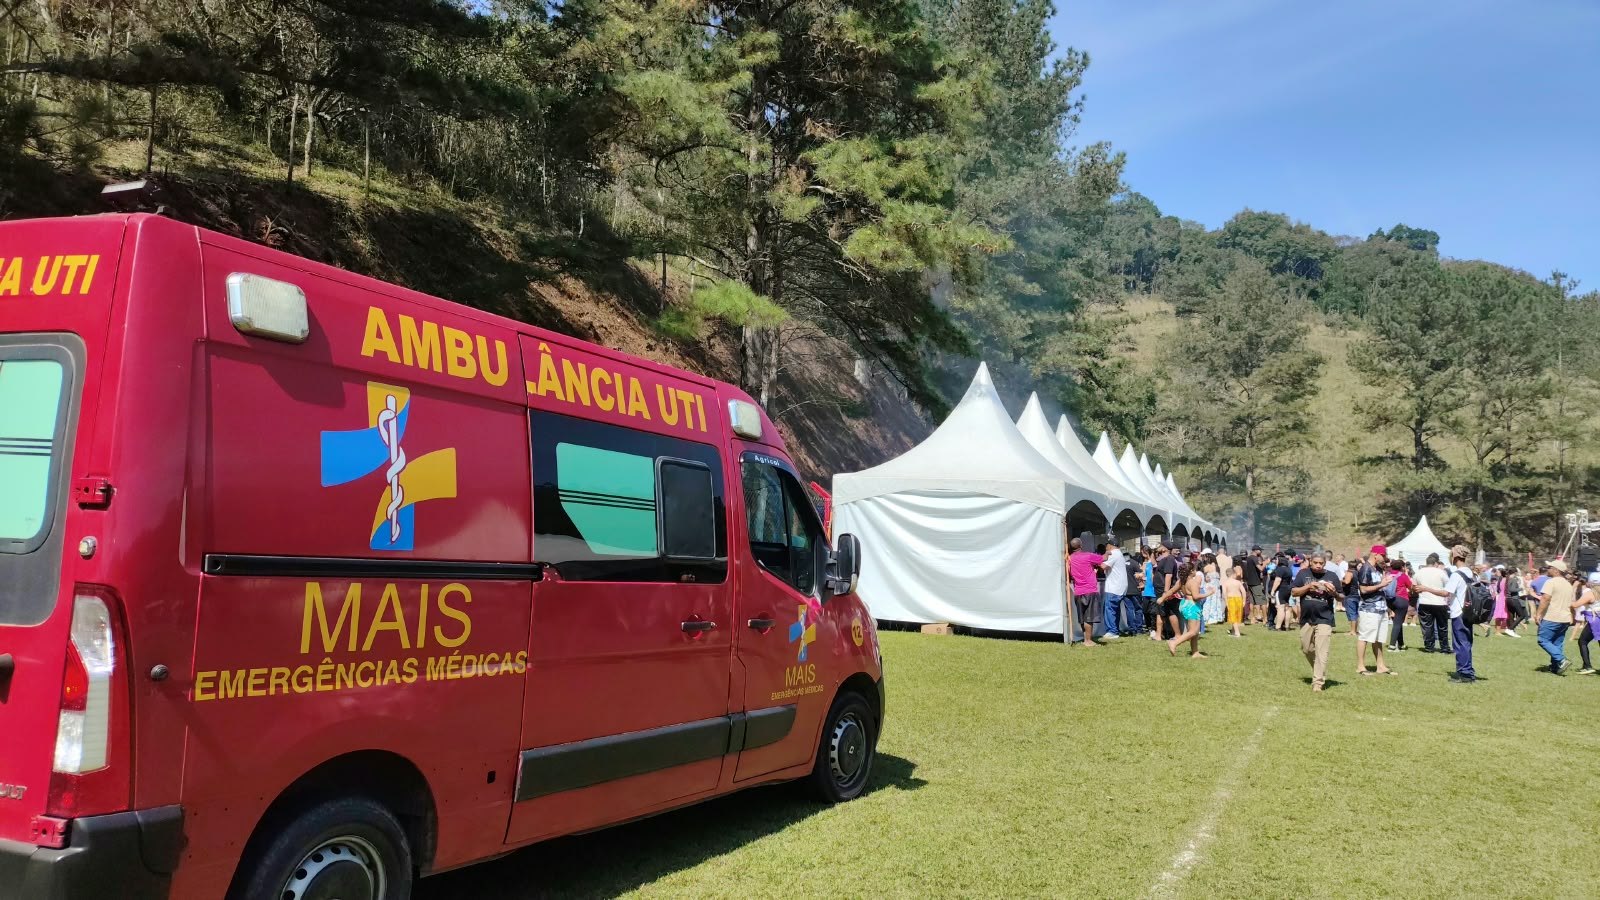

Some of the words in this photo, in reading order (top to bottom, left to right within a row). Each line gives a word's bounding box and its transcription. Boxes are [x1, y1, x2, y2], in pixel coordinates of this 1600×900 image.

[33, 254, 100, 296] UTI
[655, 384, 708, 433] UTI
[300, 582, 472, 654] MAIS
[852, 625, 862, 639] 12
[195, 657, 418, 701] EMERGÊNCIAS
[426, 650, 528, 681] MÉDICAS
[785, 663, 816, 687] MAIS
